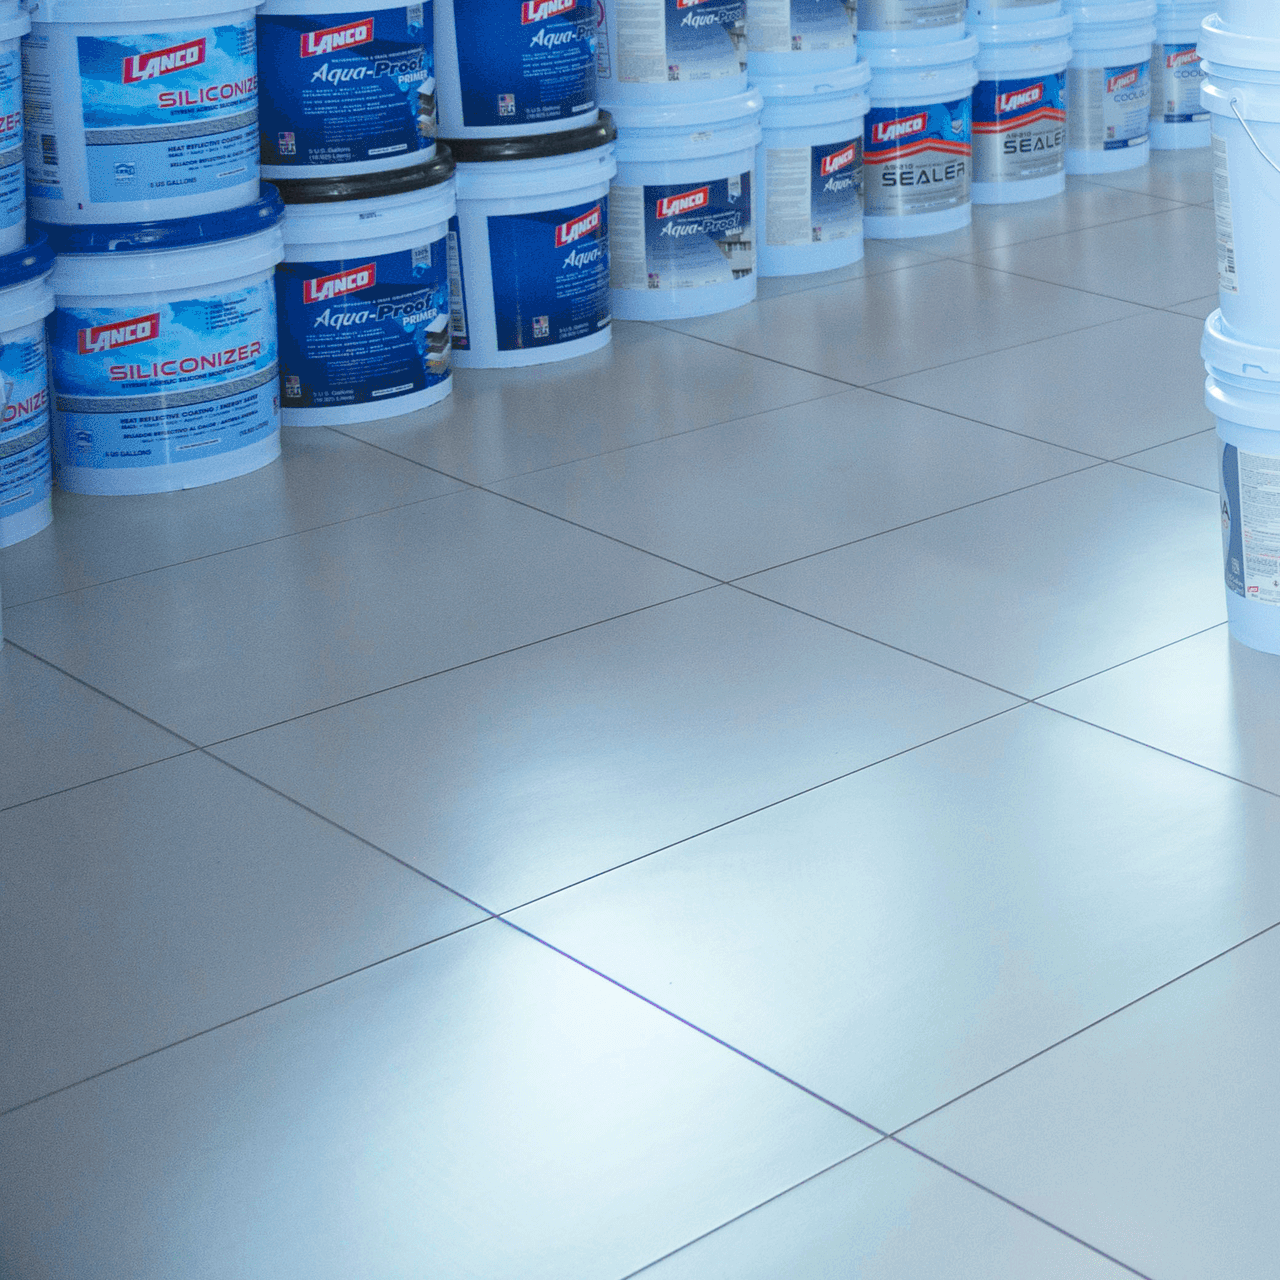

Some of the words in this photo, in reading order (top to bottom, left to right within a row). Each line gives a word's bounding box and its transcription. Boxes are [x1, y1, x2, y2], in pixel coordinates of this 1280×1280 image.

[308, 26, 367, 55] LANCO
[132, 47, 199, 81] LANCO
[310, 54, 424, 86] Aqua-Proof
[398, 70, 428, 84] PRIMER
[158, 75, 258, 108] SILICONIZE
[1111, 74, 1135, 92] LANCO
[1000, 89, 1039, 112] LANCO
[878, 119, 922, 141] LANCO
[825, 148, 853, 174] LANCO
[882, 162, 965, 186] SEALER
[663, 192, 703, 215] LANCO
[561, 212, 598, 244] LANCO
[660, 212, 740, 238] Aqua-Proof
[311, 271, 369, 301] LANCO
[314, 292, 432, 330] Aqua-Proof
[403, 308, 438, 326] PRIMER
[85, 320, 151, 352] LANCO
[110, 341, 261, 381] SILICONIZER
